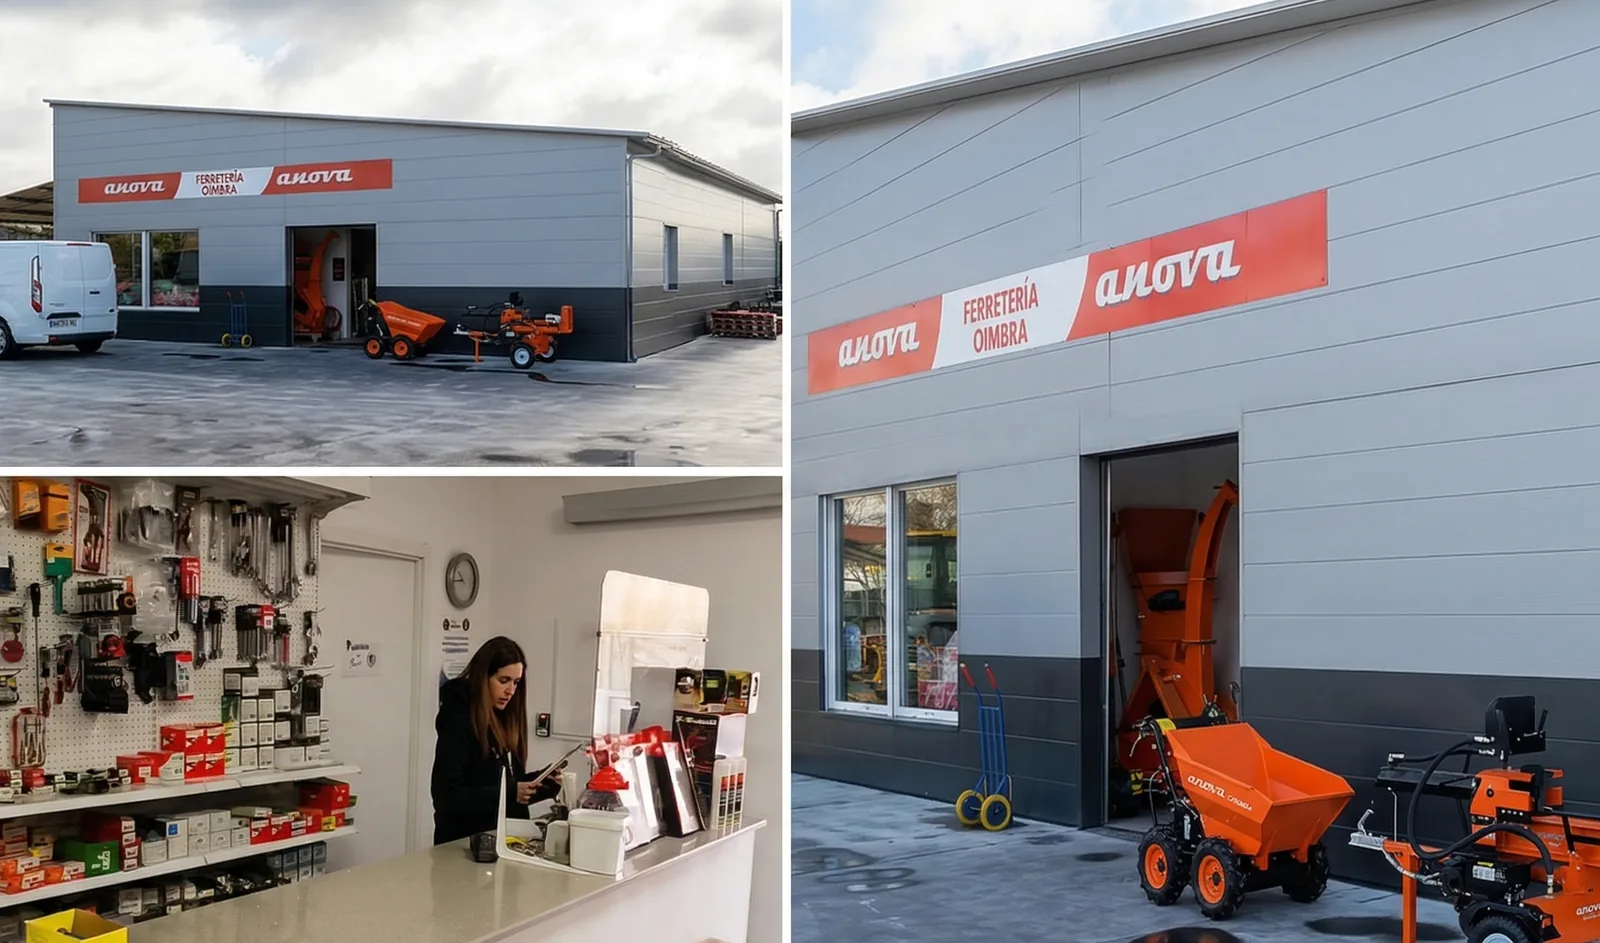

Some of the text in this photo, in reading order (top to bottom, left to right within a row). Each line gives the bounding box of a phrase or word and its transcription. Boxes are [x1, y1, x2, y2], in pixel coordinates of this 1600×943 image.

[104, 179, 166, 195] anova
[201, 183, 238, 195] OIMBRA
[276, 168, 354, 186] anova
[1095, 239, 1241, 307] anova
[963, 276, 1039, 325] FERRETERÍA
[838, 321, 920, 368] anova
[973, 319, 1028, 354] OIMBRA
[1187, 775, 1225, 799] anova
[1576, 903, 1600, 916] anov
